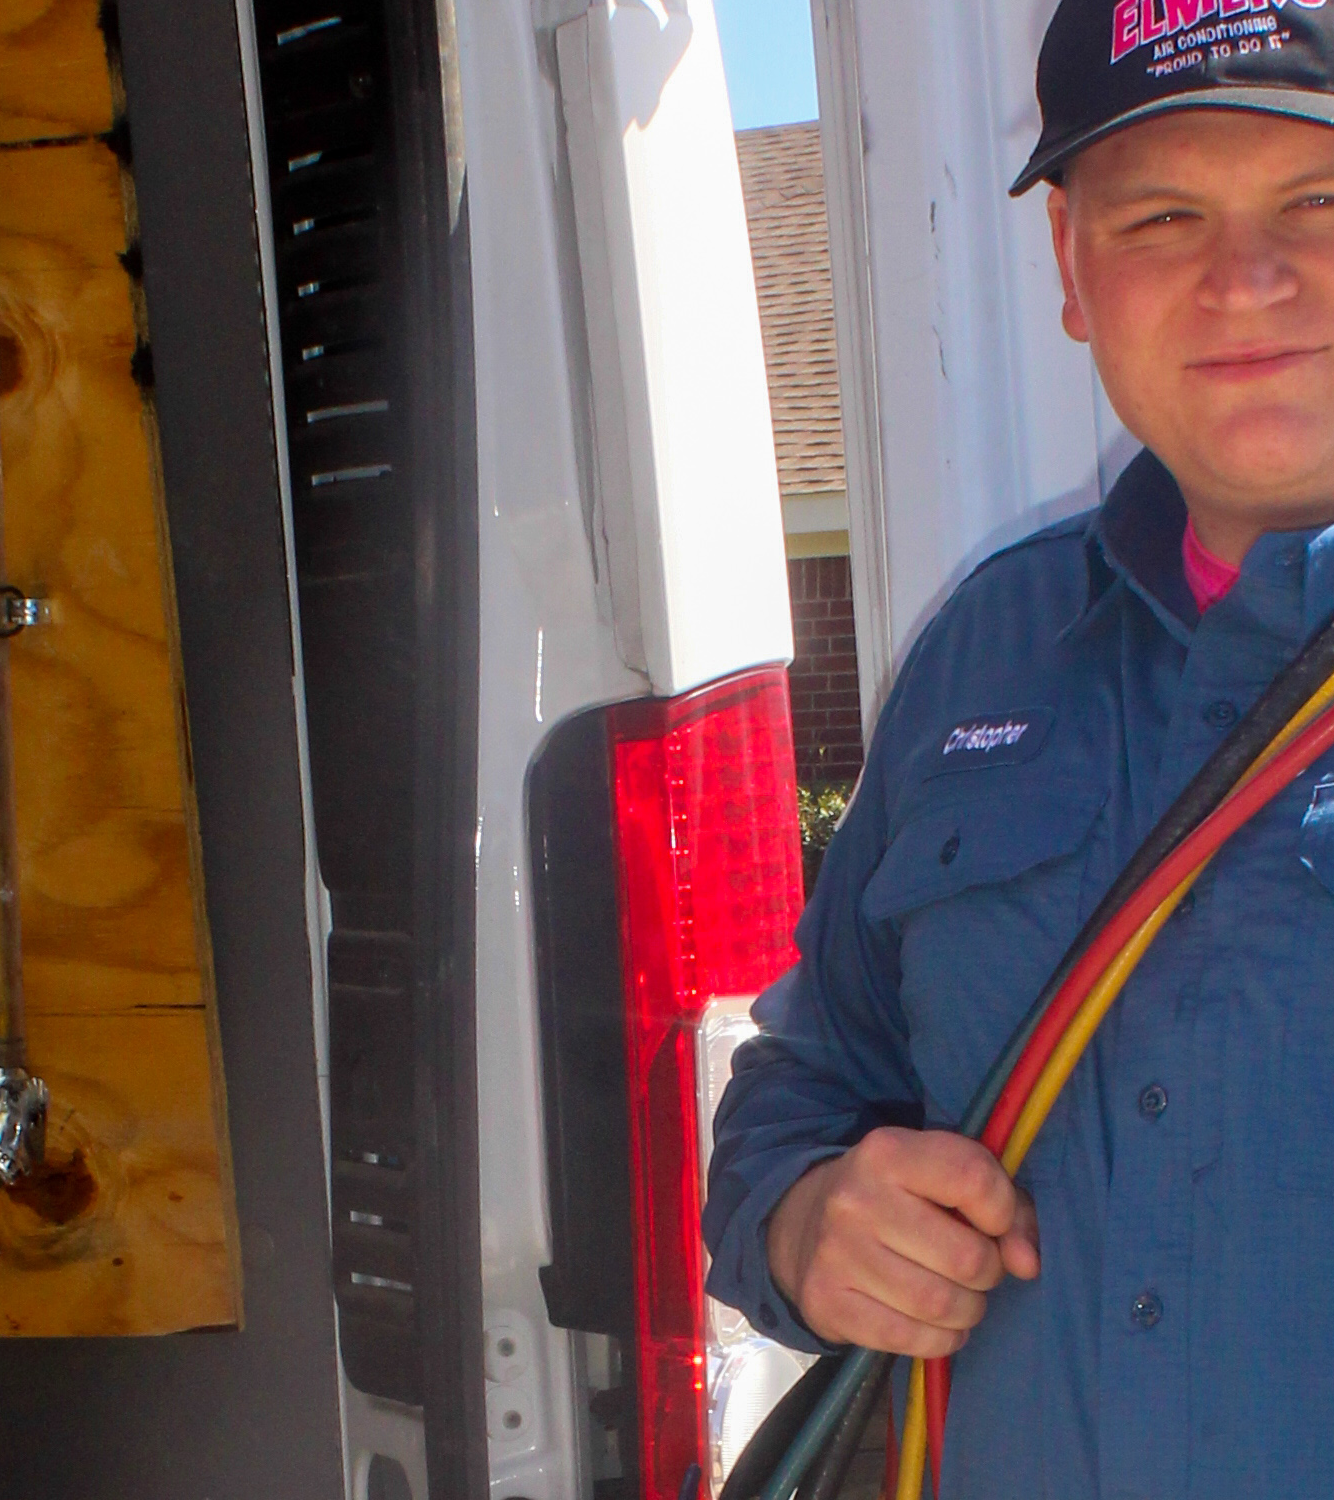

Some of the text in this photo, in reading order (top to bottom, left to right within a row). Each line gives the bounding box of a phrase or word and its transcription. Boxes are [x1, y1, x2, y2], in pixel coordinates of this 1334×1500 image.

[1153, 15, 1278, 61] AIR CONDITIONING
[1210, 43, 1232, 60] TO
[1238, 38, 1262, 55] DO
[942, 720, 1029, 755] Christopher
